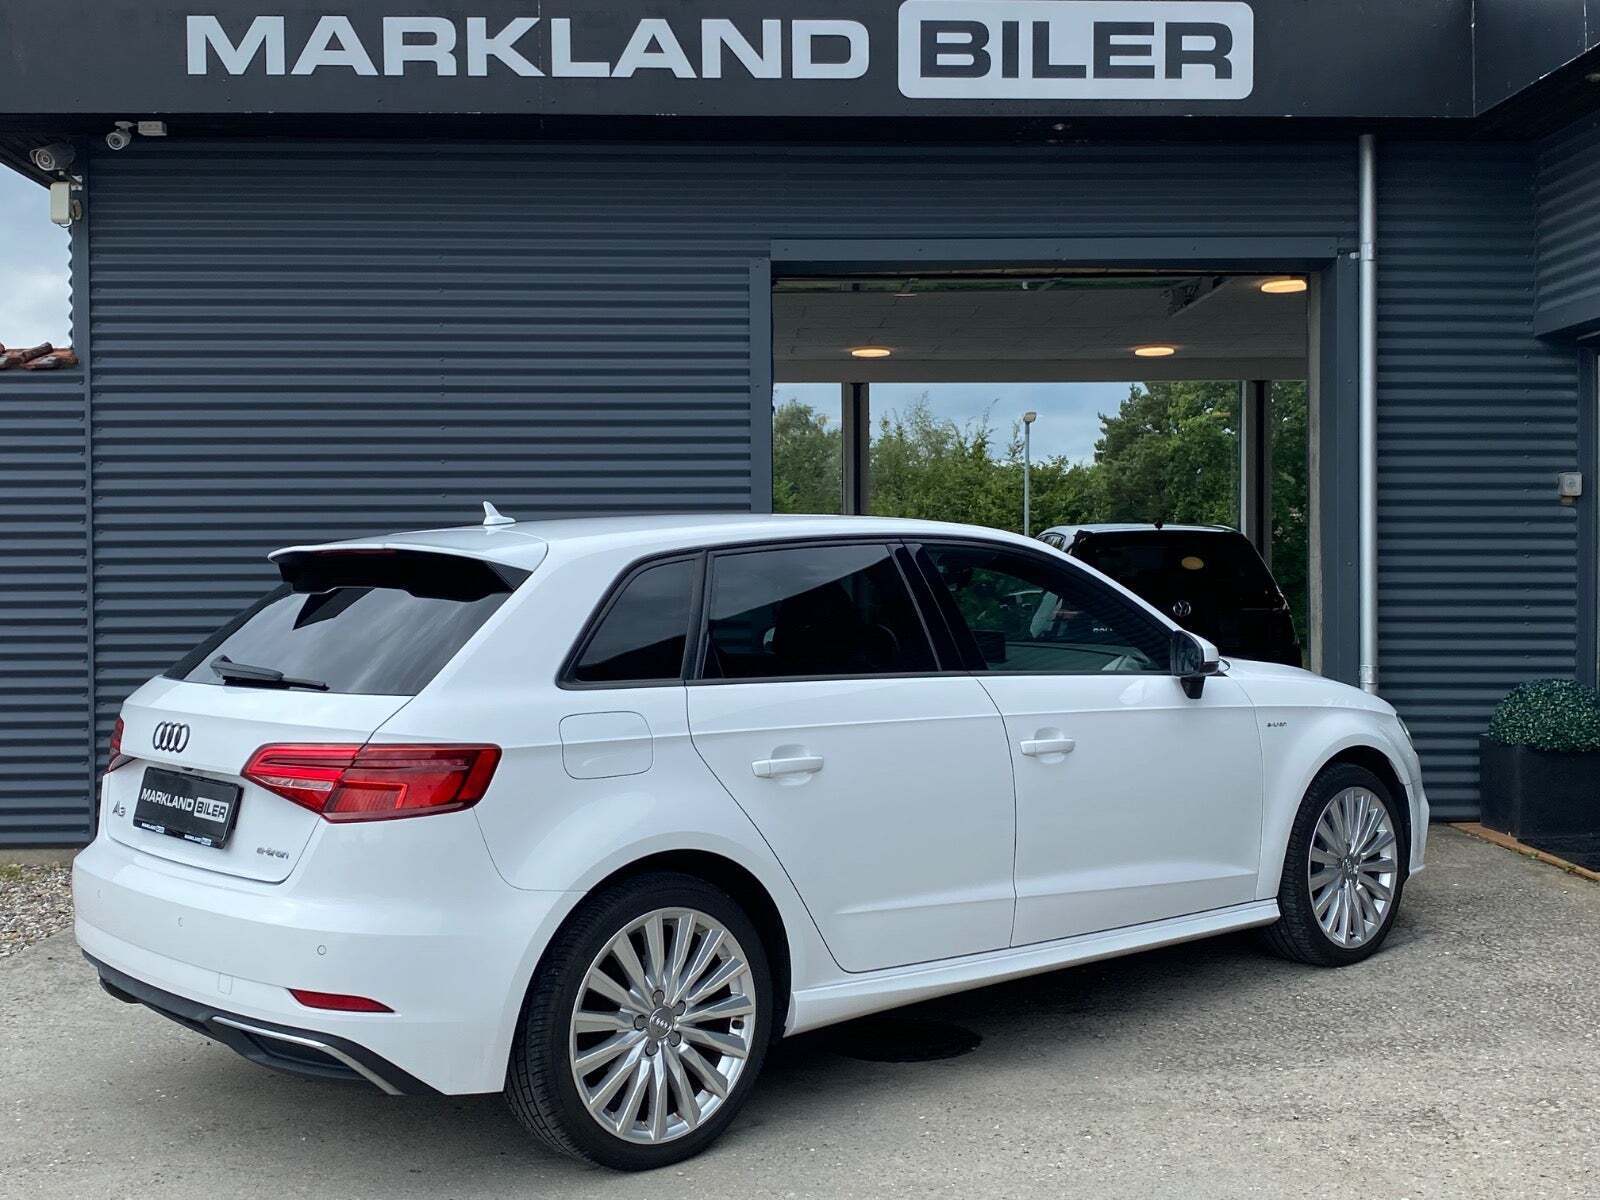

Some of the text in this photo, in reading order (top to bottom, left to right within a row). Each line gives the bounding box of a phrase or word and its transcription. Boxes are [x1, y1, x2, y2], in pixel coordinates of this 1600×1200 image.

[187, 15, 1233, 80] MARKLAND BILER
[112, 800, 126, 818] A3
[141, 789, 226, 820] MARKLAND BILER
